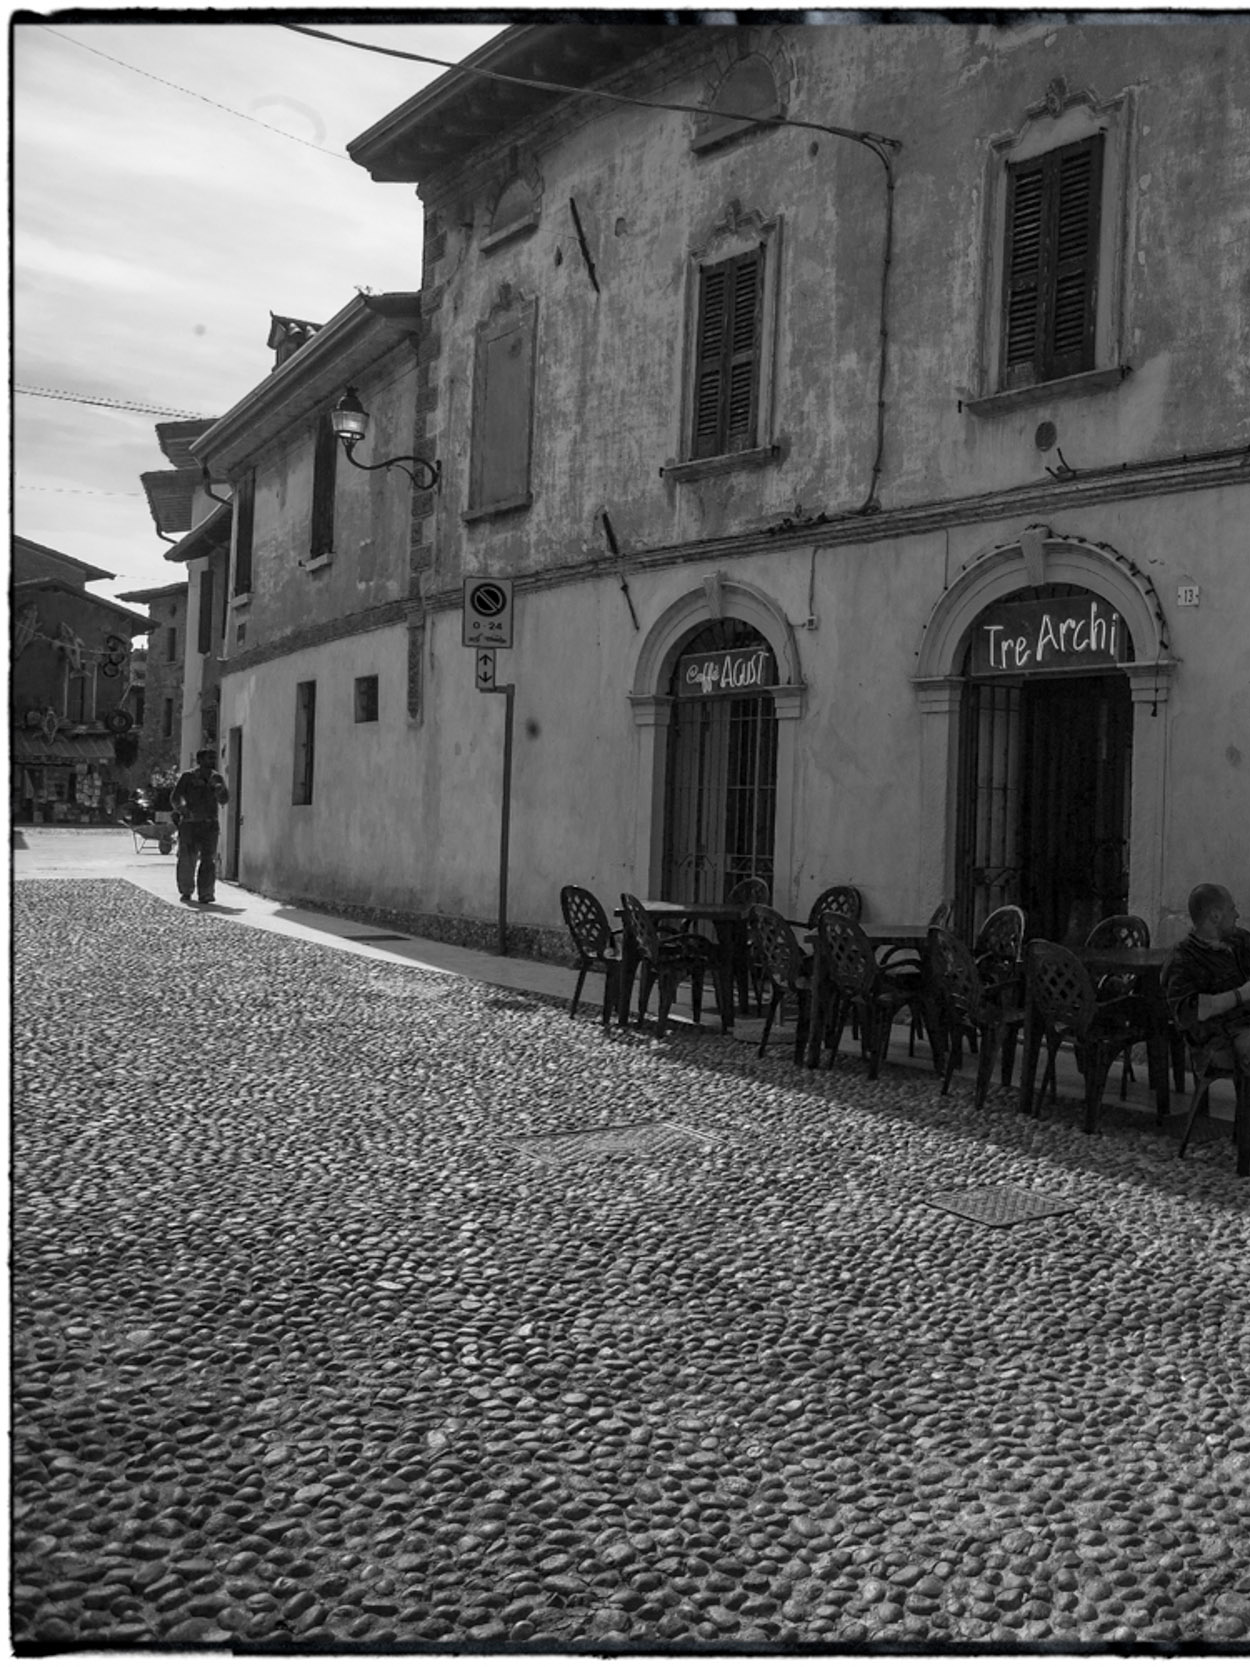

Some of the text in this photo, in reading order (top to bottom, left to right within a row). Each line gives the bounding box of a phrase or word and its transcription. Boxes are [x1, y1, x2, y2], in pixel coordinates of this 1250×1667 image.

[1184, 589, 1194, 603] 13
[983, 600, 1119, 669] Tre Archi
[720, 651, 770, 688] AGUST
